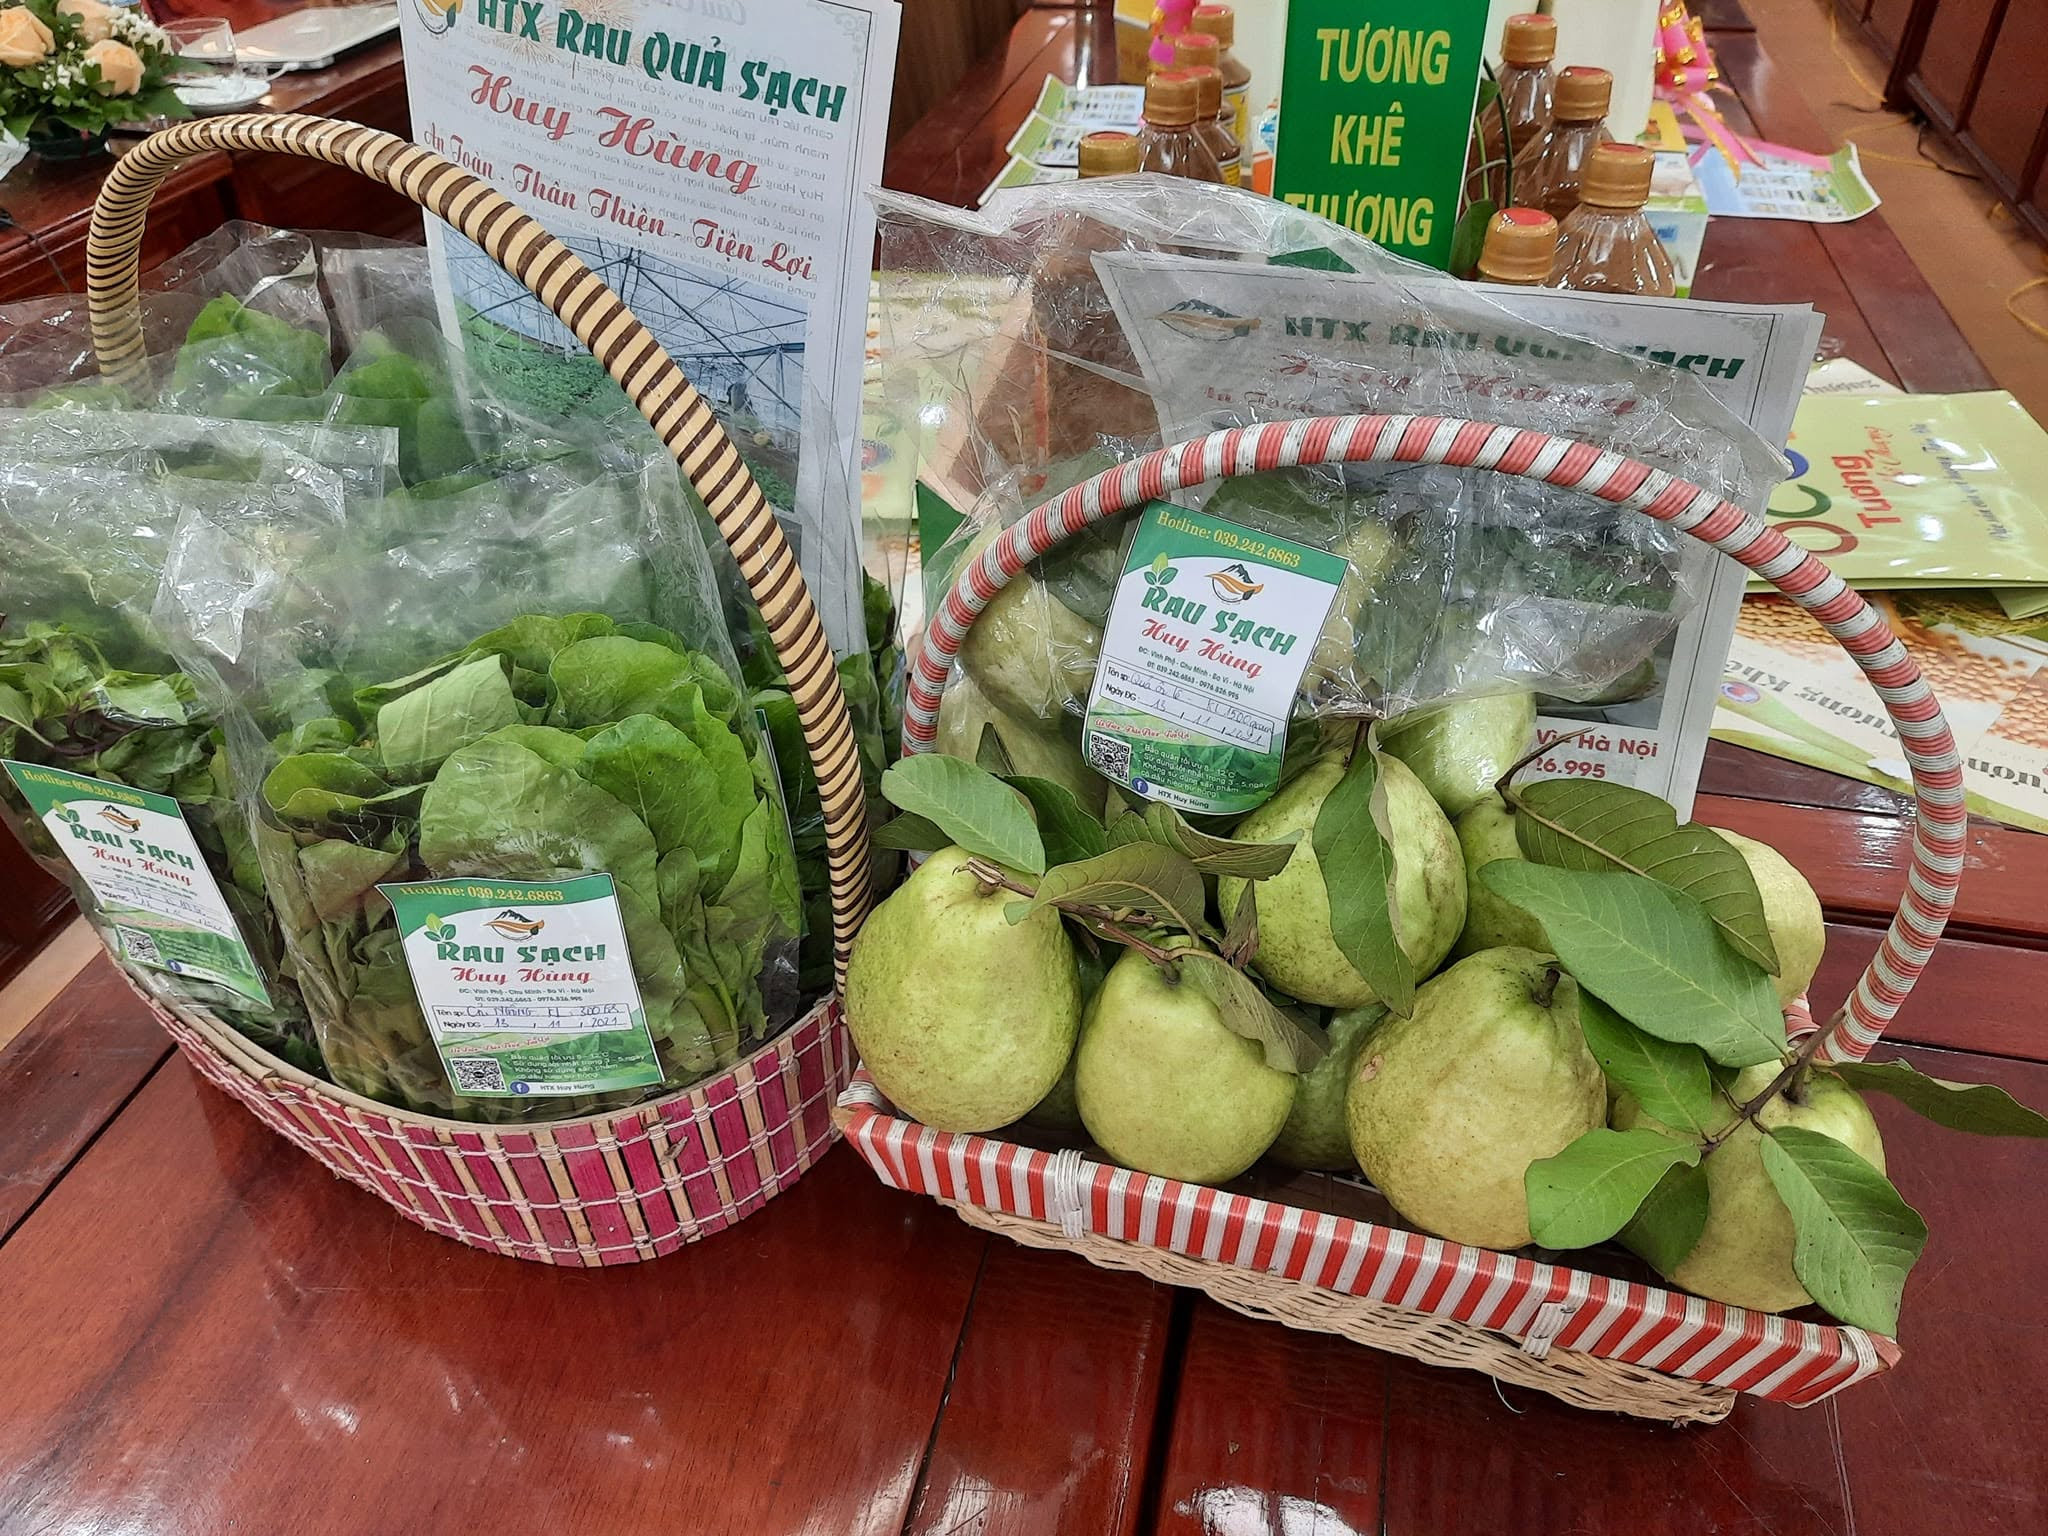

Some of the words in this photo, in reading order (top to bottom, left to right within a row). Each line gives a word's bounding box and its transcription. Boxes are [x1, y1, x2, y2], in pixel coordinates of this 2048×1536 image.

[477, 0, 544, 42] HTX
[556, 9, 632, 66] RAU
[642, 35, 728, 92] QUẢ
[739, 60, 847, 122] SẠCH
[1316, 21, 1451, 86] TƯƠNG
[467, 64, 575, 141] Huy
[596, 106, 761, 194] Hùng
[1329, 100, 1406, 167] KHÊ
[424, 122, 446, 155] An
[450, 134, 495, 180] Toàn
[512, 163, 578, 210] Thân
[588, 188, 666, 237] Thiện
[692, 218, 757, 263] Tiện
[762, 242, 813, 282] Lợi
[1830, 456, 1902, 529] Tương
[1156, 511, 1211, 539] Hotline:
[1213, 529, 1301, 568] 039.242.6863
[1141, 586, 1207, 625] RAU
[1209, 610, 1297, 655] SẠCH
[1141, 618, 1190, 653] Huy
[1197, 637, 1264, 679] Hùng
[1193, 665, 1208, 677] Minh
[1105, 683, 1125, 698] Ngày
[1794, 686, 1899, 738] Tương
[1578, 734, 1610, 752] Hà
[1618, 738, 1658, 761] Nội
[1158, 789, 1172, 799] HTX
[1173, 794, 1188, 804] Huy
[1189, 798, 1209, 809] Hùng
[70, 823, 124, 849] RAU
[129, 838, 195, 871] SẠCH
[88, 845, 133, 868] Huy
[467, 885, 564, 901] 039.242.6863
[437, 942, 505, 963] RAU
[516, 943, 606, 966] SẠCH
[449, 966, 508, 985] Huy
[516, 967, 593, 985] Hùng
[443, 1021, 466, 1029] Ngày
